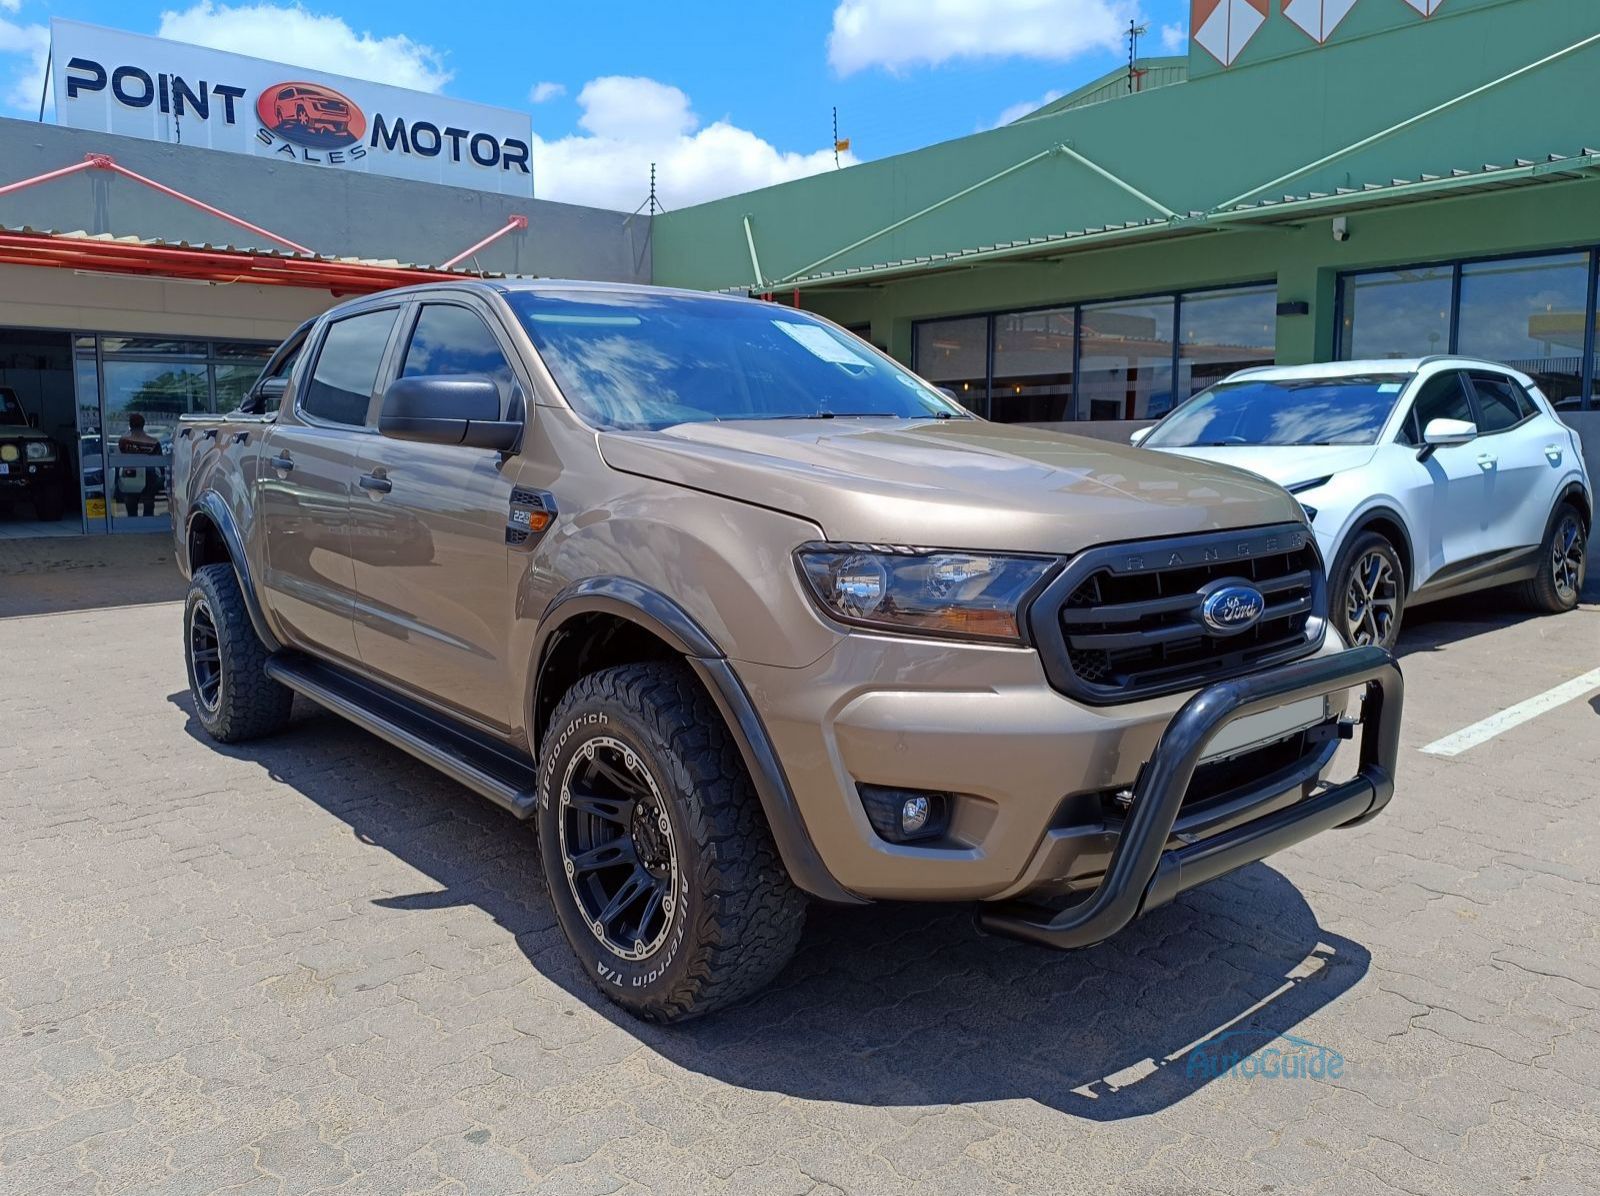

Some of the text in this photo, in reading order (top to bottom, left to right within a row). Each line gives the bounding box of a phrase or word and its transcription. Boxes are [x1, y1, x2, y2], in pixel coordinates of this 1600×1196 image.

[66, 56, 531, 174] POINT MOTOR
[256, 127, 367, 164] SALES
[1126, 533, 1302, 570] RANGER
[1221, 595, 1258, 622] Ford
[542, 711, 609, 811] BFGoodrich
[597, 960, 623, 987] T/A
